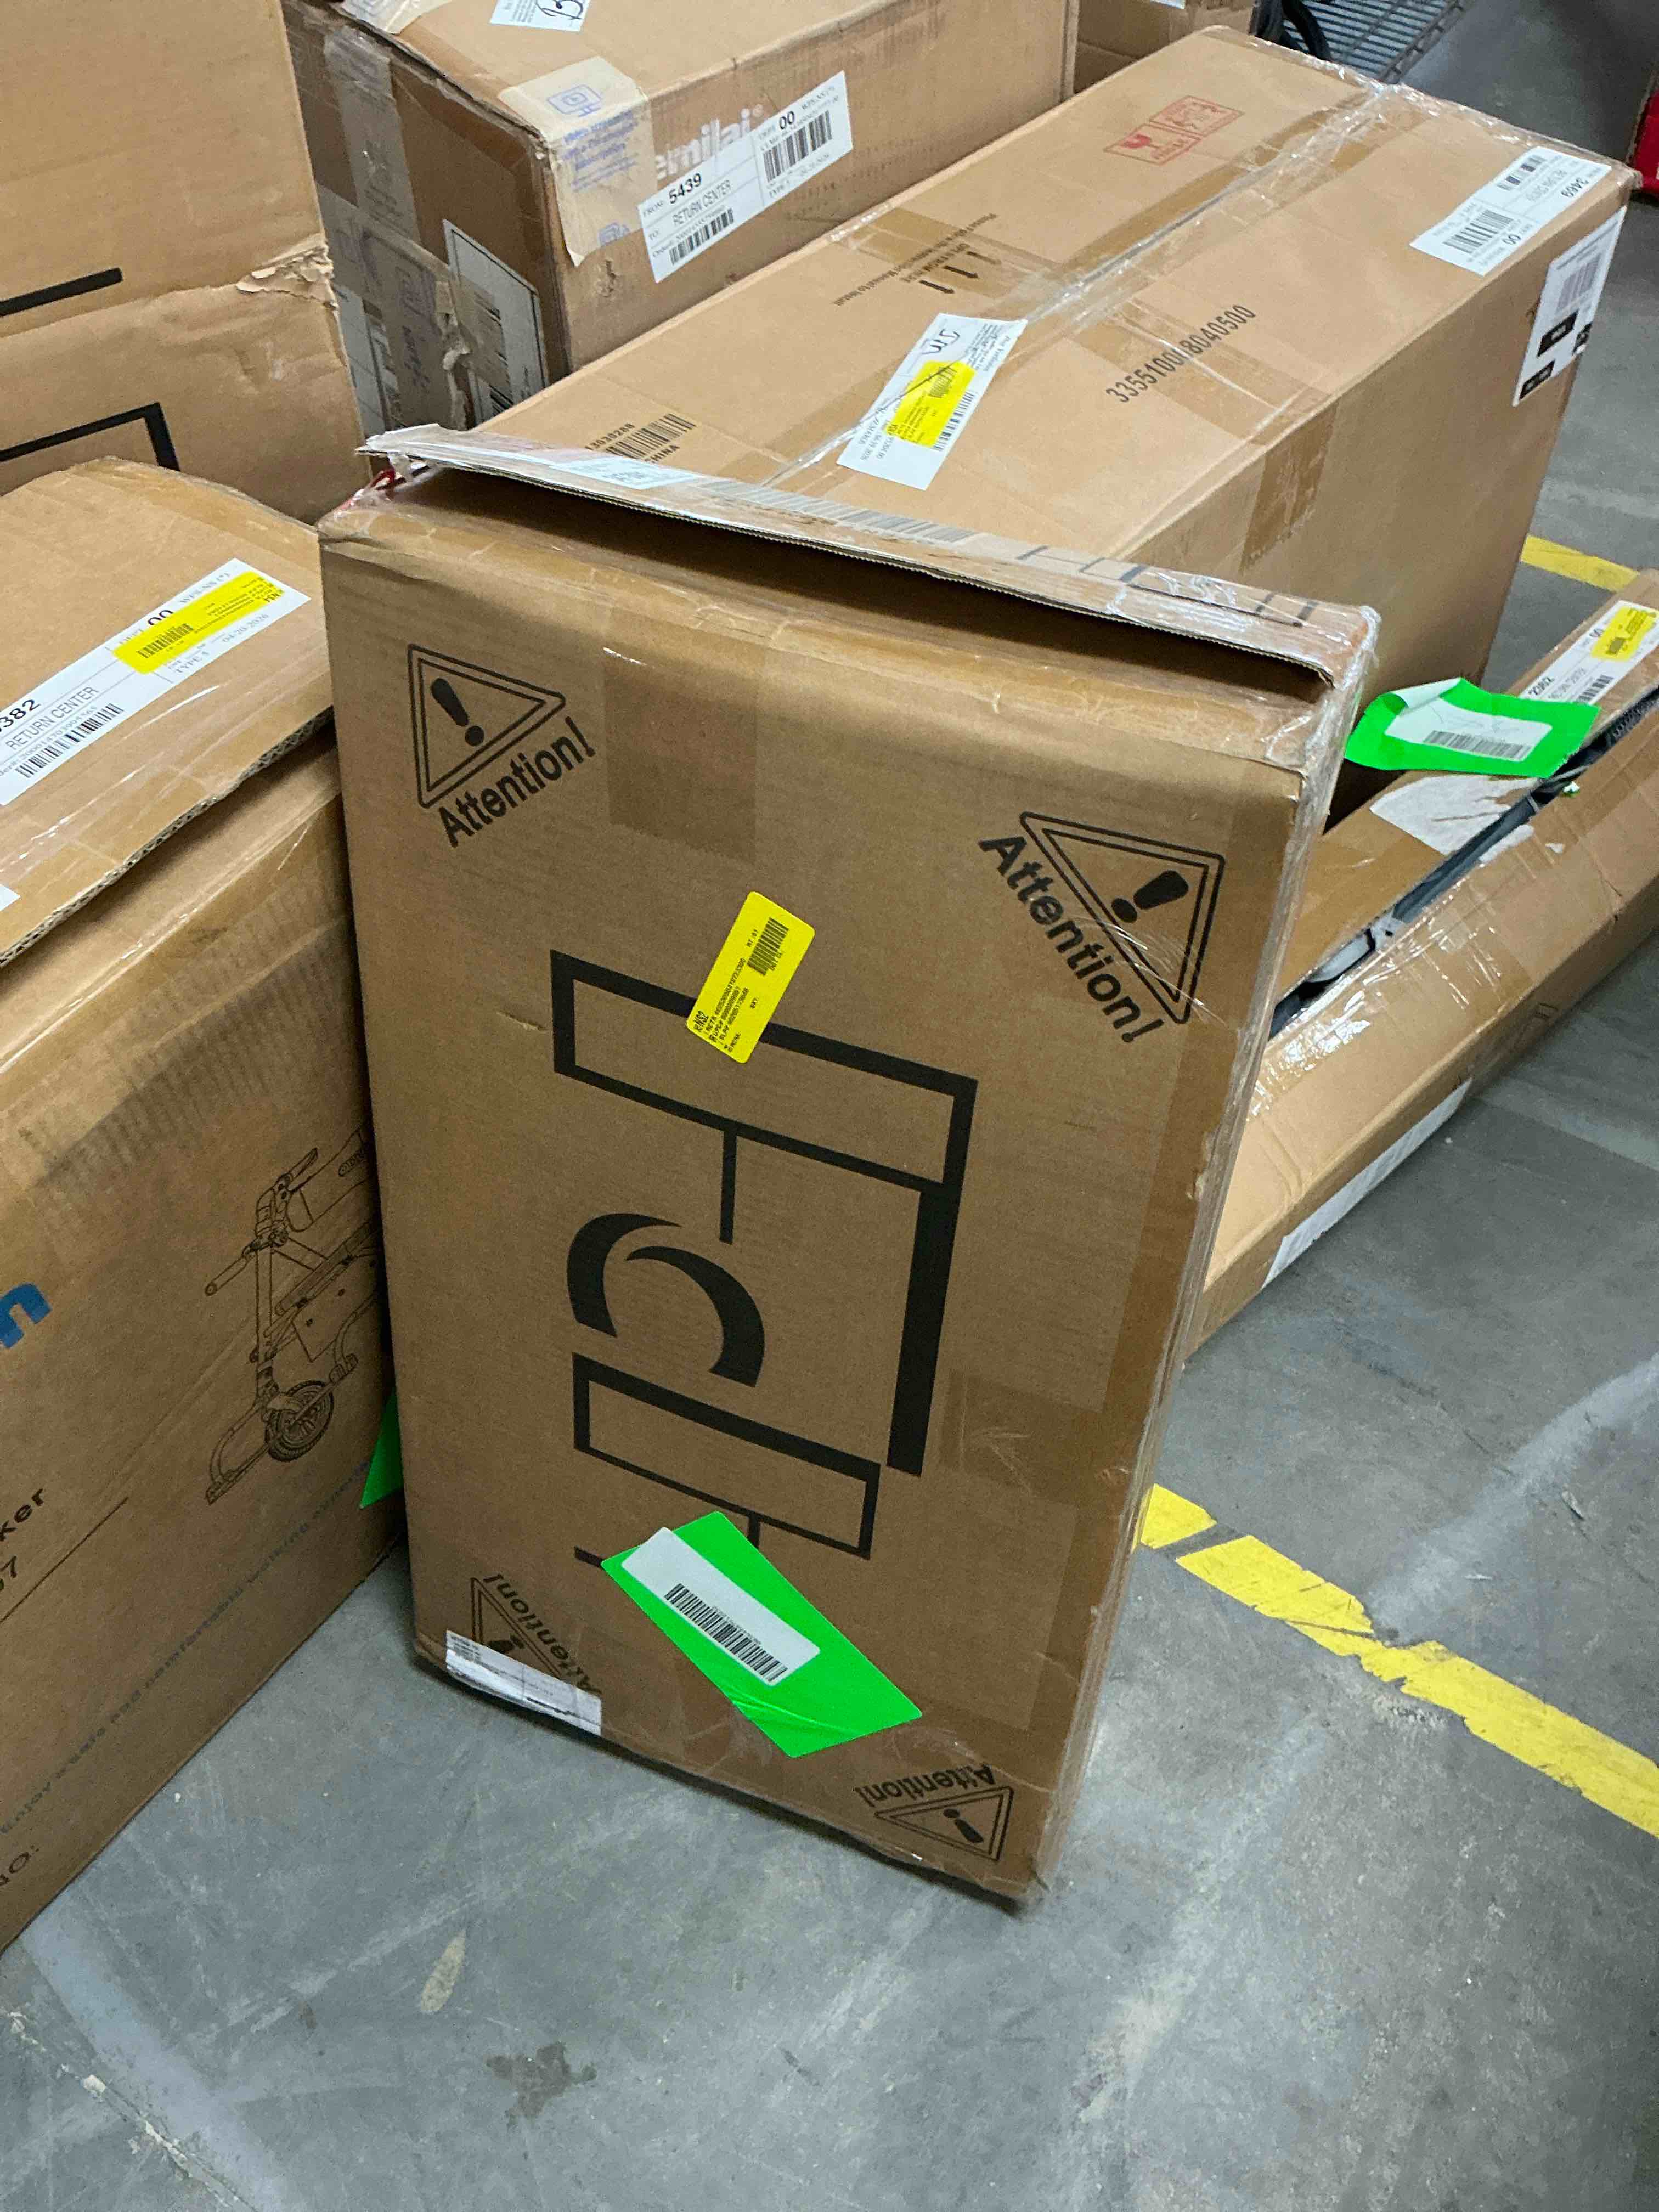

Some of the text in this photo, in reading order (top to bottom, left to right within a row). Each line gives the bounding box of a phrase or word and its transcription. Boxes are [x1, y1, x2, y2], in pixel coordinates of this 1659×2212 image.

[779, 111, 795, 130] 00
[668, 173, 702, 204] 5439
[0, 699, 42, 733] 382
[5, 686, 100, 751] RETURN CENTER
[438, 716, 596, 848] Attention!
[978, 836, 1165, 1042] Attention!
[853, 1764, 995, 1808] Attention!
